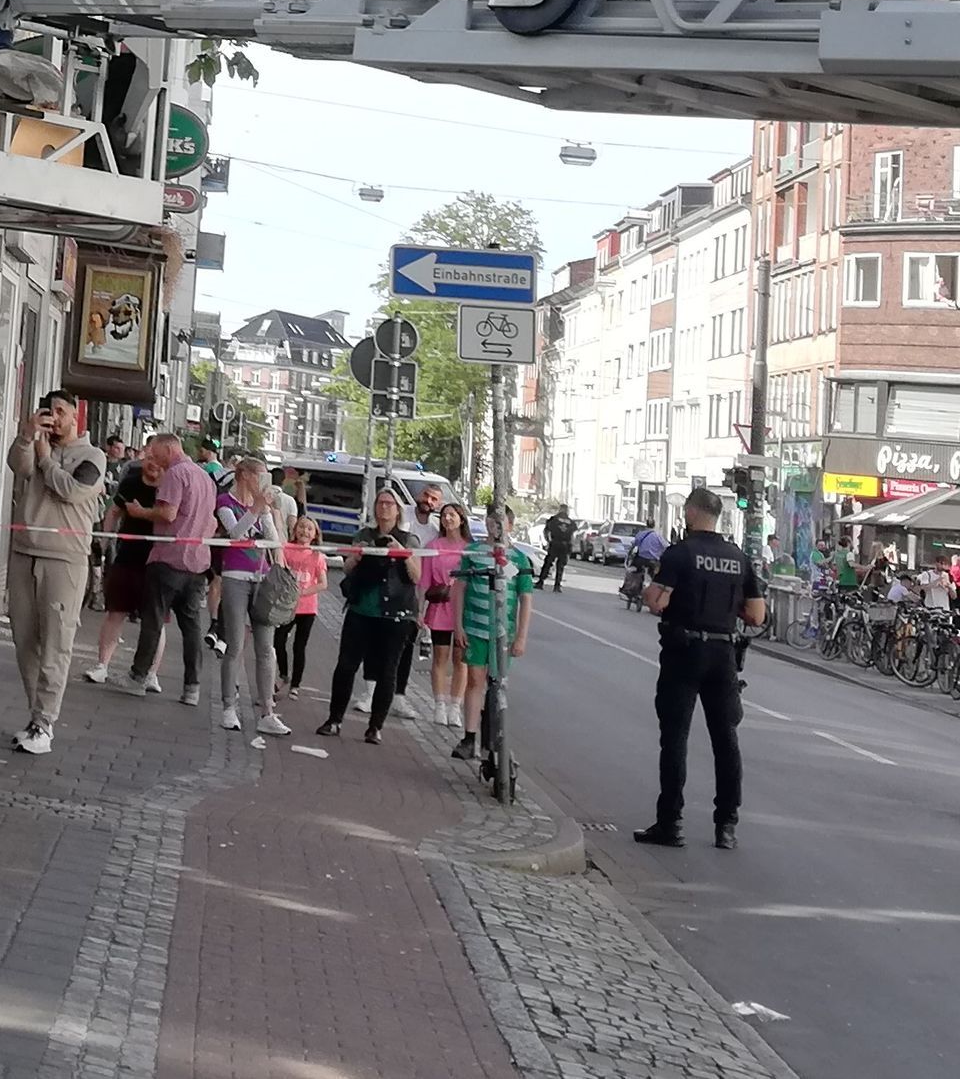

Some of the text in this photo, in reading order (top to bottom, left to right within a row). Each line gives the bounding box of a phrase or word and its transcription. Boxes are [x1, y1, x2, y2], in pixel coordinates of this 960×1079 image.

[433, 268, 527, 285] Einbahnstraße
[877, 444, 940, 474] Pizza,
[696, 555, 741, 574] POLIZEI
